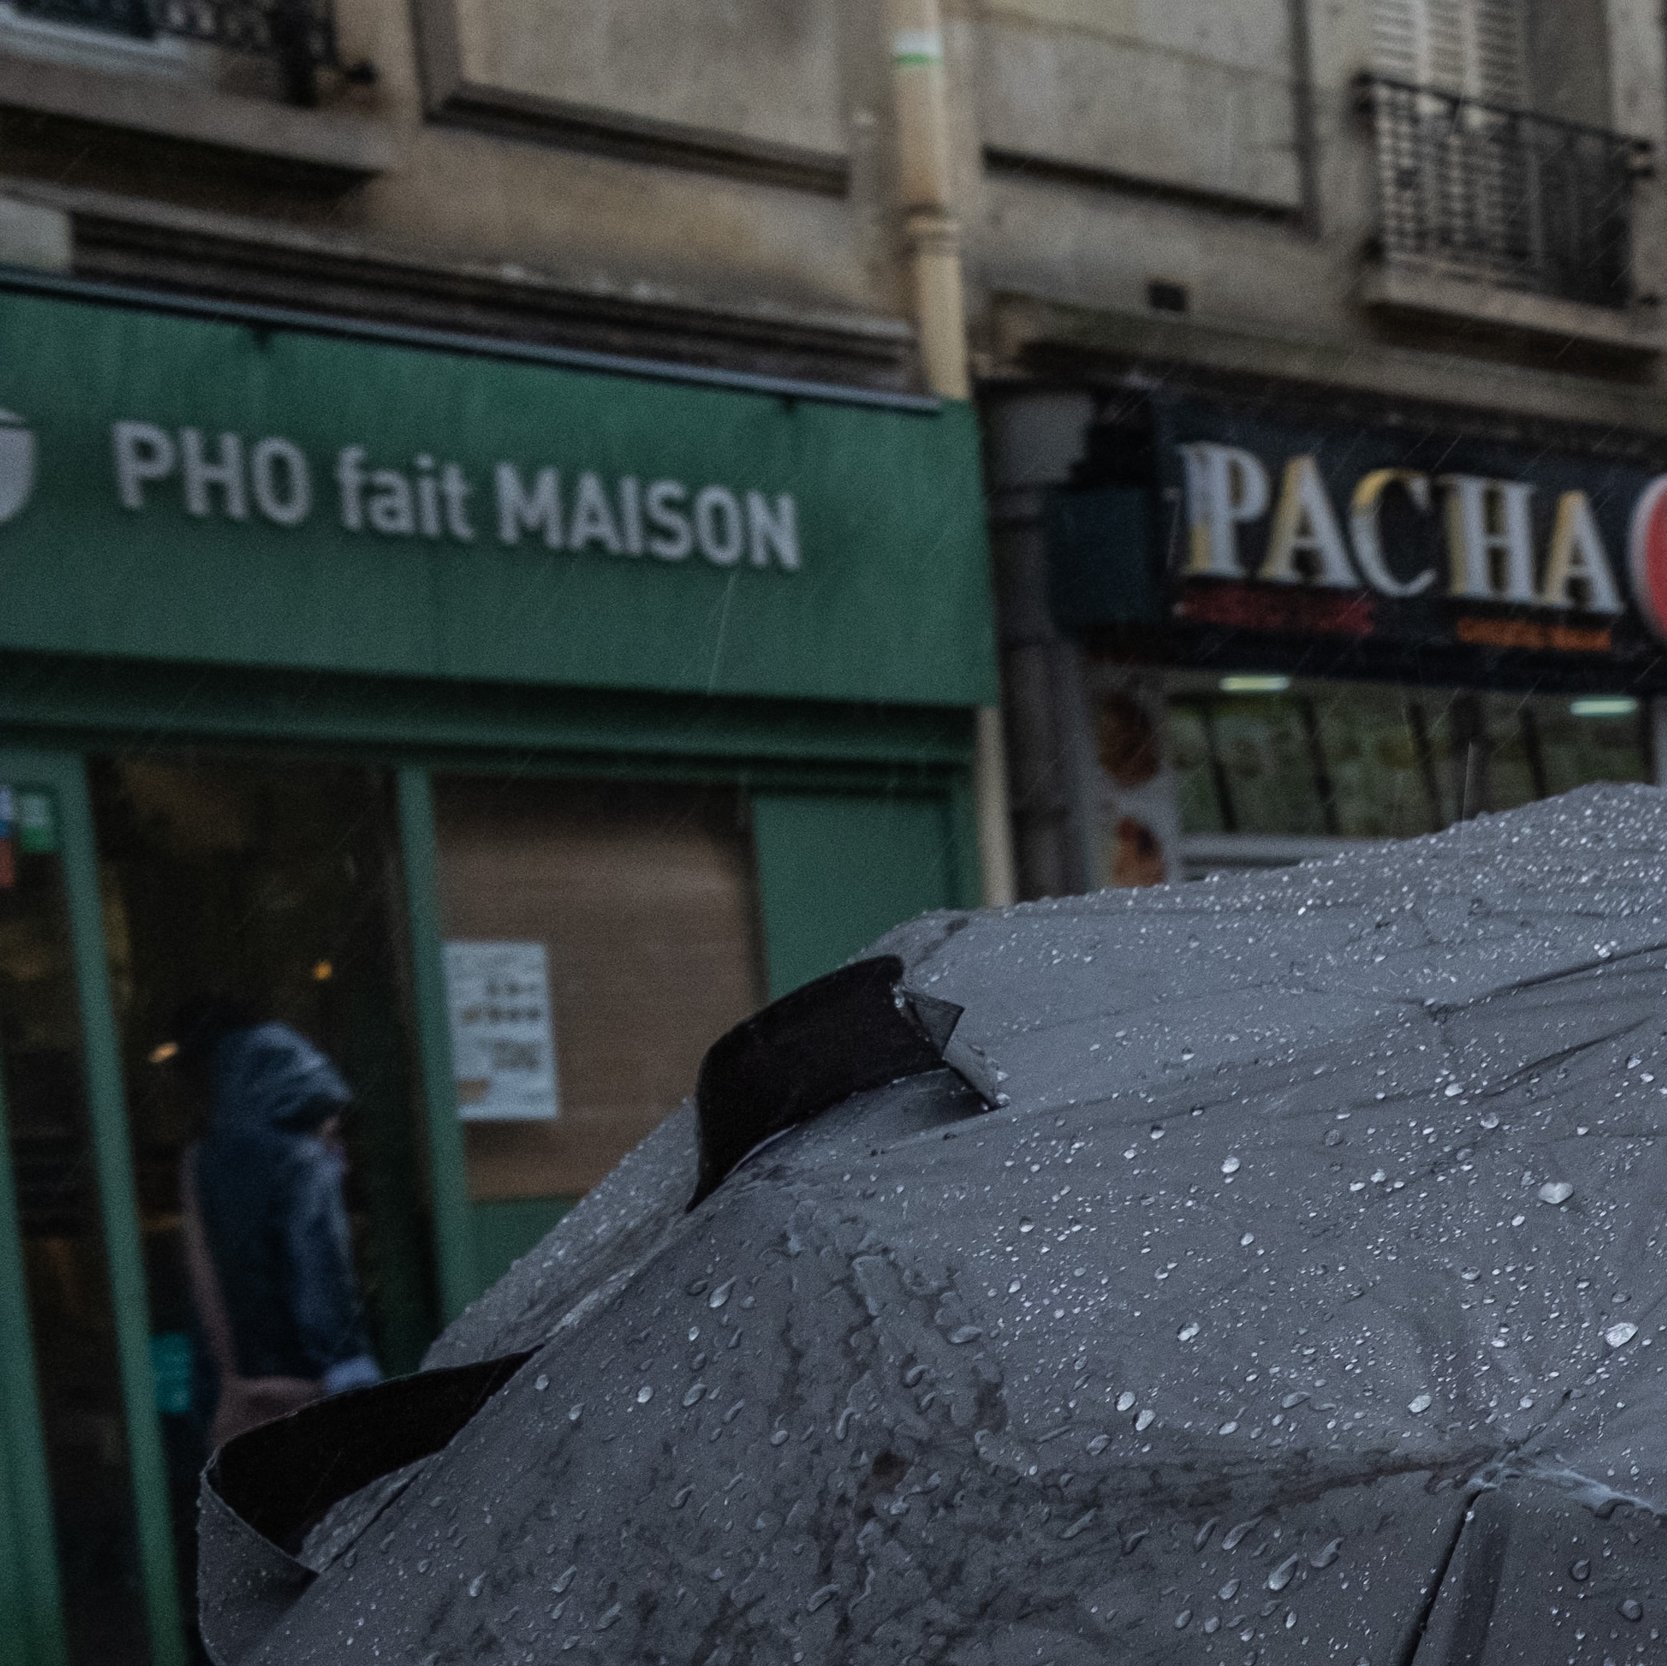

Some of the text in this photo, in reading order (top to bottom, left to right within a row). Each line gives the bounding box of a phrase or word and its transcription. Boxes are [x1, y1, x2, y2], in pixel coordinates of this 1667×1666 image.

[111, 419, 801, 571] PHO fait MAISON
[1178, 439, 1625, 616] PACHA
